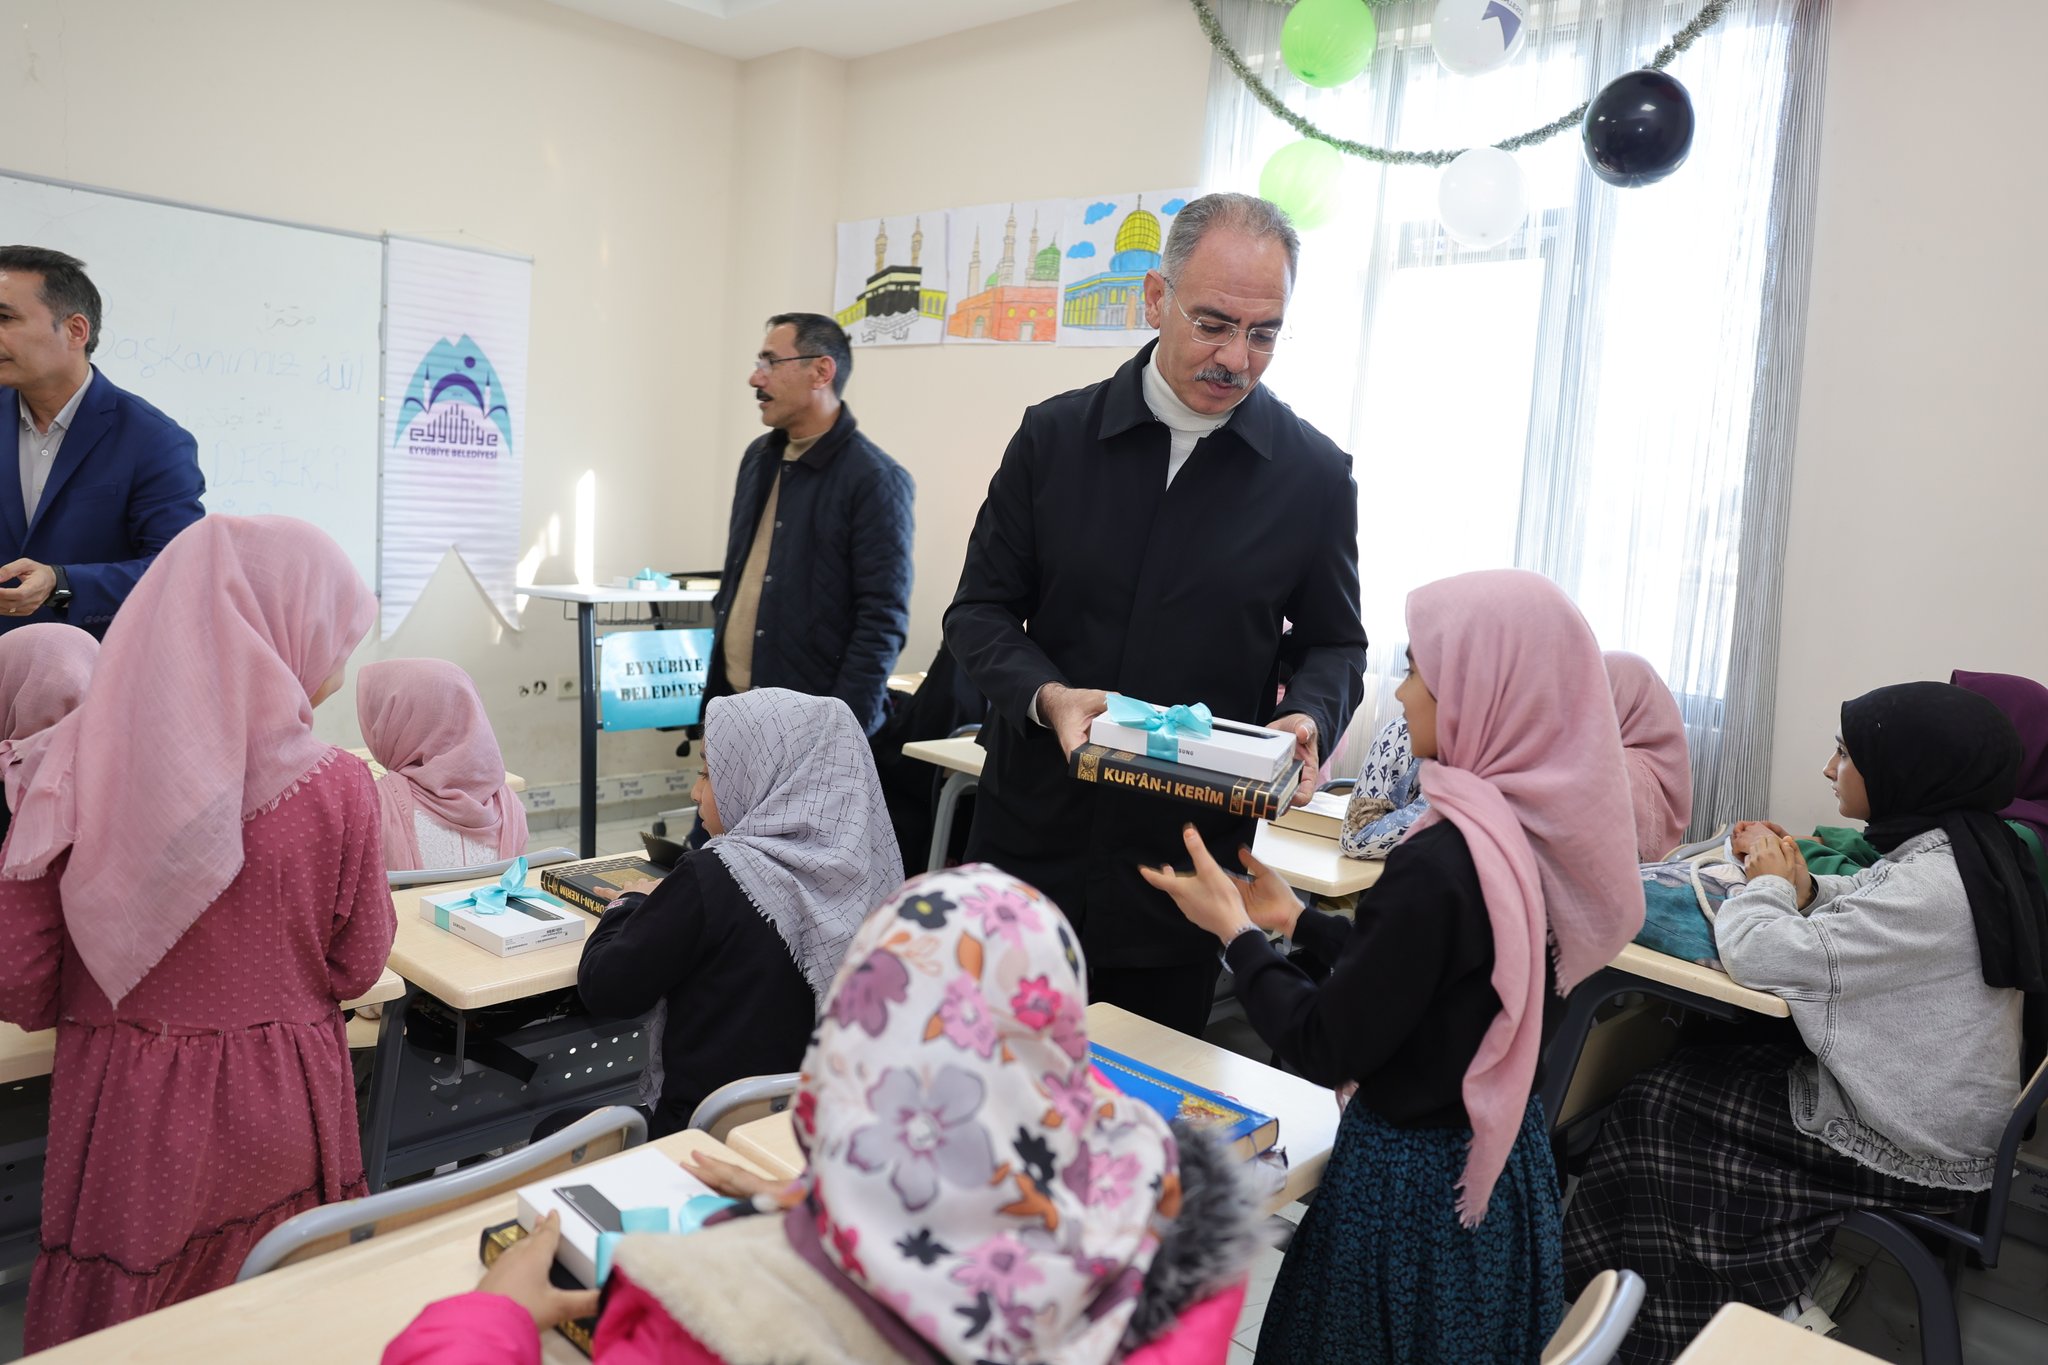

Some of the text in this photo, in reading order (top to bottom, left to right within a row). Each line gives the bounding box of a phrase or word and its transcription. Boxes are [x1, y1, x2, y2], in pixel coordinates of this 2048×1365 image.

[409, 403, 498, 446] eyyübiye
[408, 445, 498, 459] EYYÜBİYE BELEDİYESİ
[625, 656, 704, 676] EYYÜBİYE
[1174, 782, 1224, 806] KERÎM
